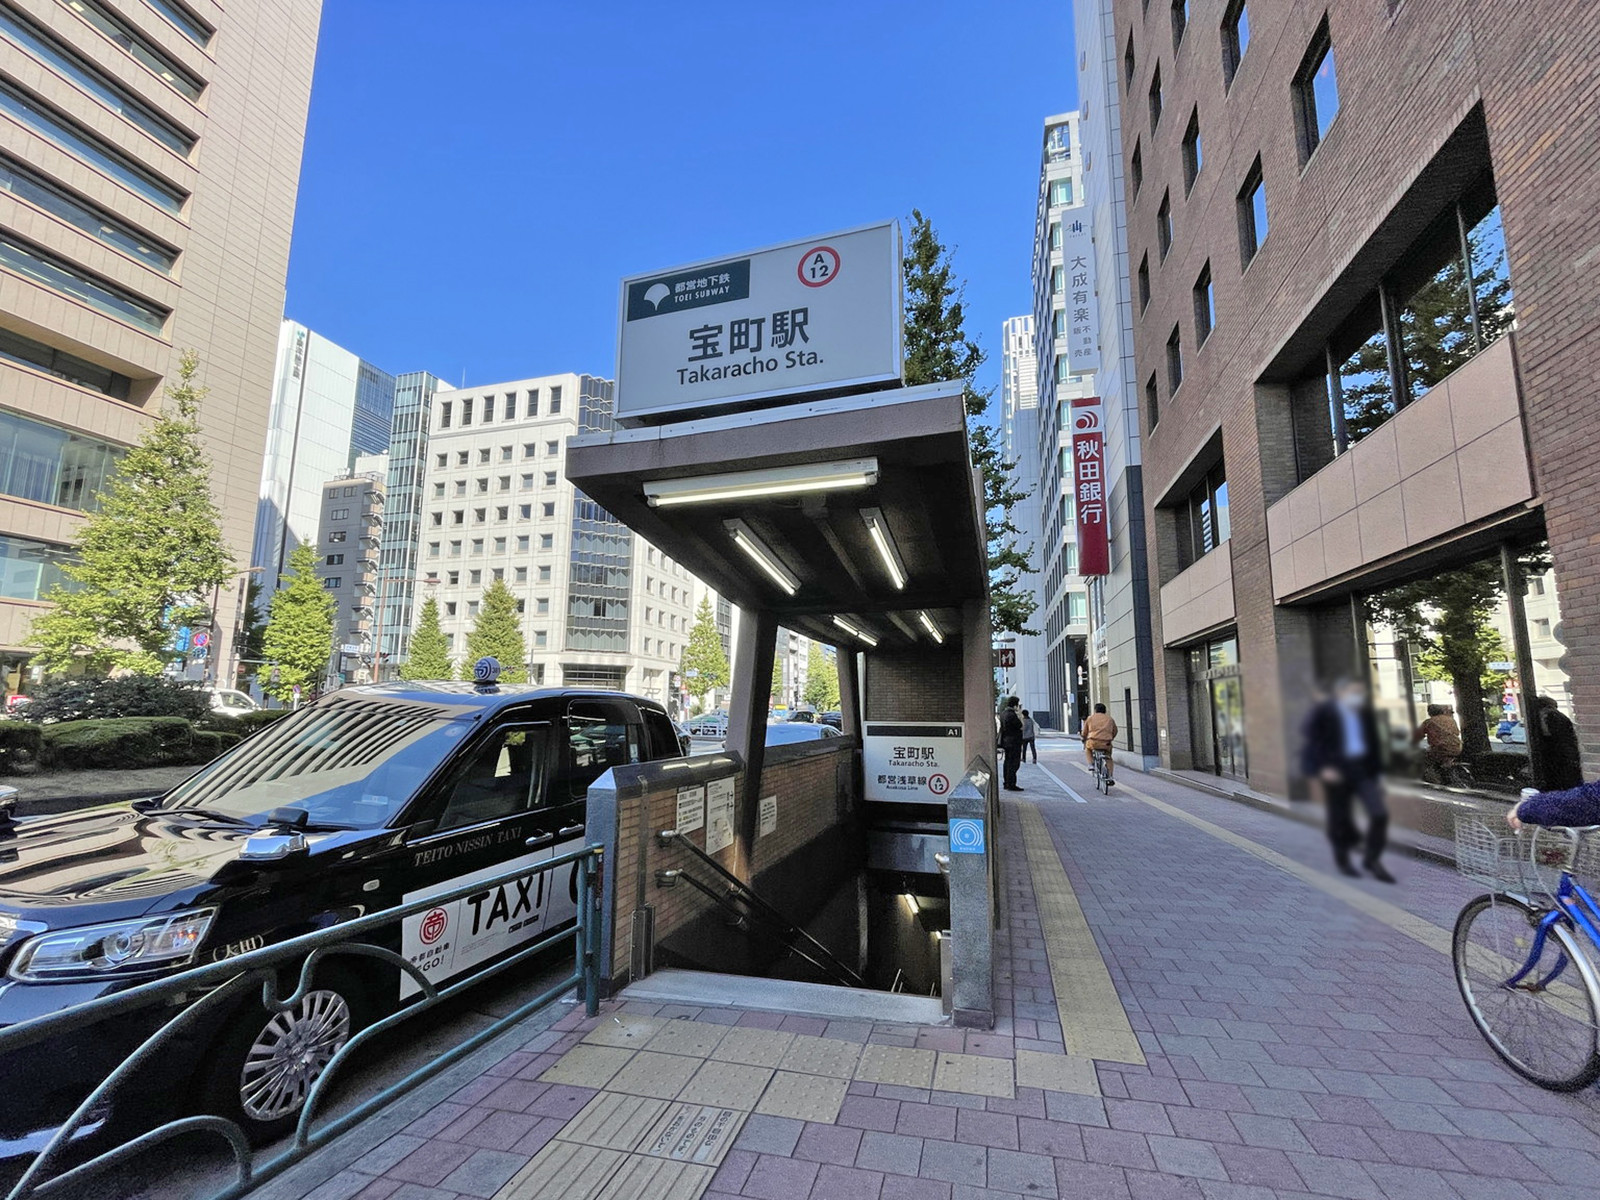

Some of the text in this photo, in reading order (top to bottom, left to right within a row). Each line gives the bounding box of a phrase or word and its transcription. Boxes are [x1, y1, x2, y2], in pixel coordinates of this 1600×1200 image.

[813, 253, 825, 266] A
[810, 265, 829, 279] 12
[674, 272, 731, 294] 都営地下鉄
[1070, 255, 1090, 323] 大成有楽
[674, 286, 730, 303] TOEI SUBWAY
[688, 307, 810, 362] 宝町駅
[677, 350, 824, 385] Takaracho Sta.
[1076, 440, 1103, 525] 秋田銀行
[947, 728, 959, 736] A1
[893, 746, 935, 760] 宝町駅
[888, 759, 940, 768] Takaracho Sta.
[877, 774, 927, 786] 都営浅草線
[413, 826, 522, 868] TEITO NISSIN TAXI
[467, 870, 545, 936] TAXI
